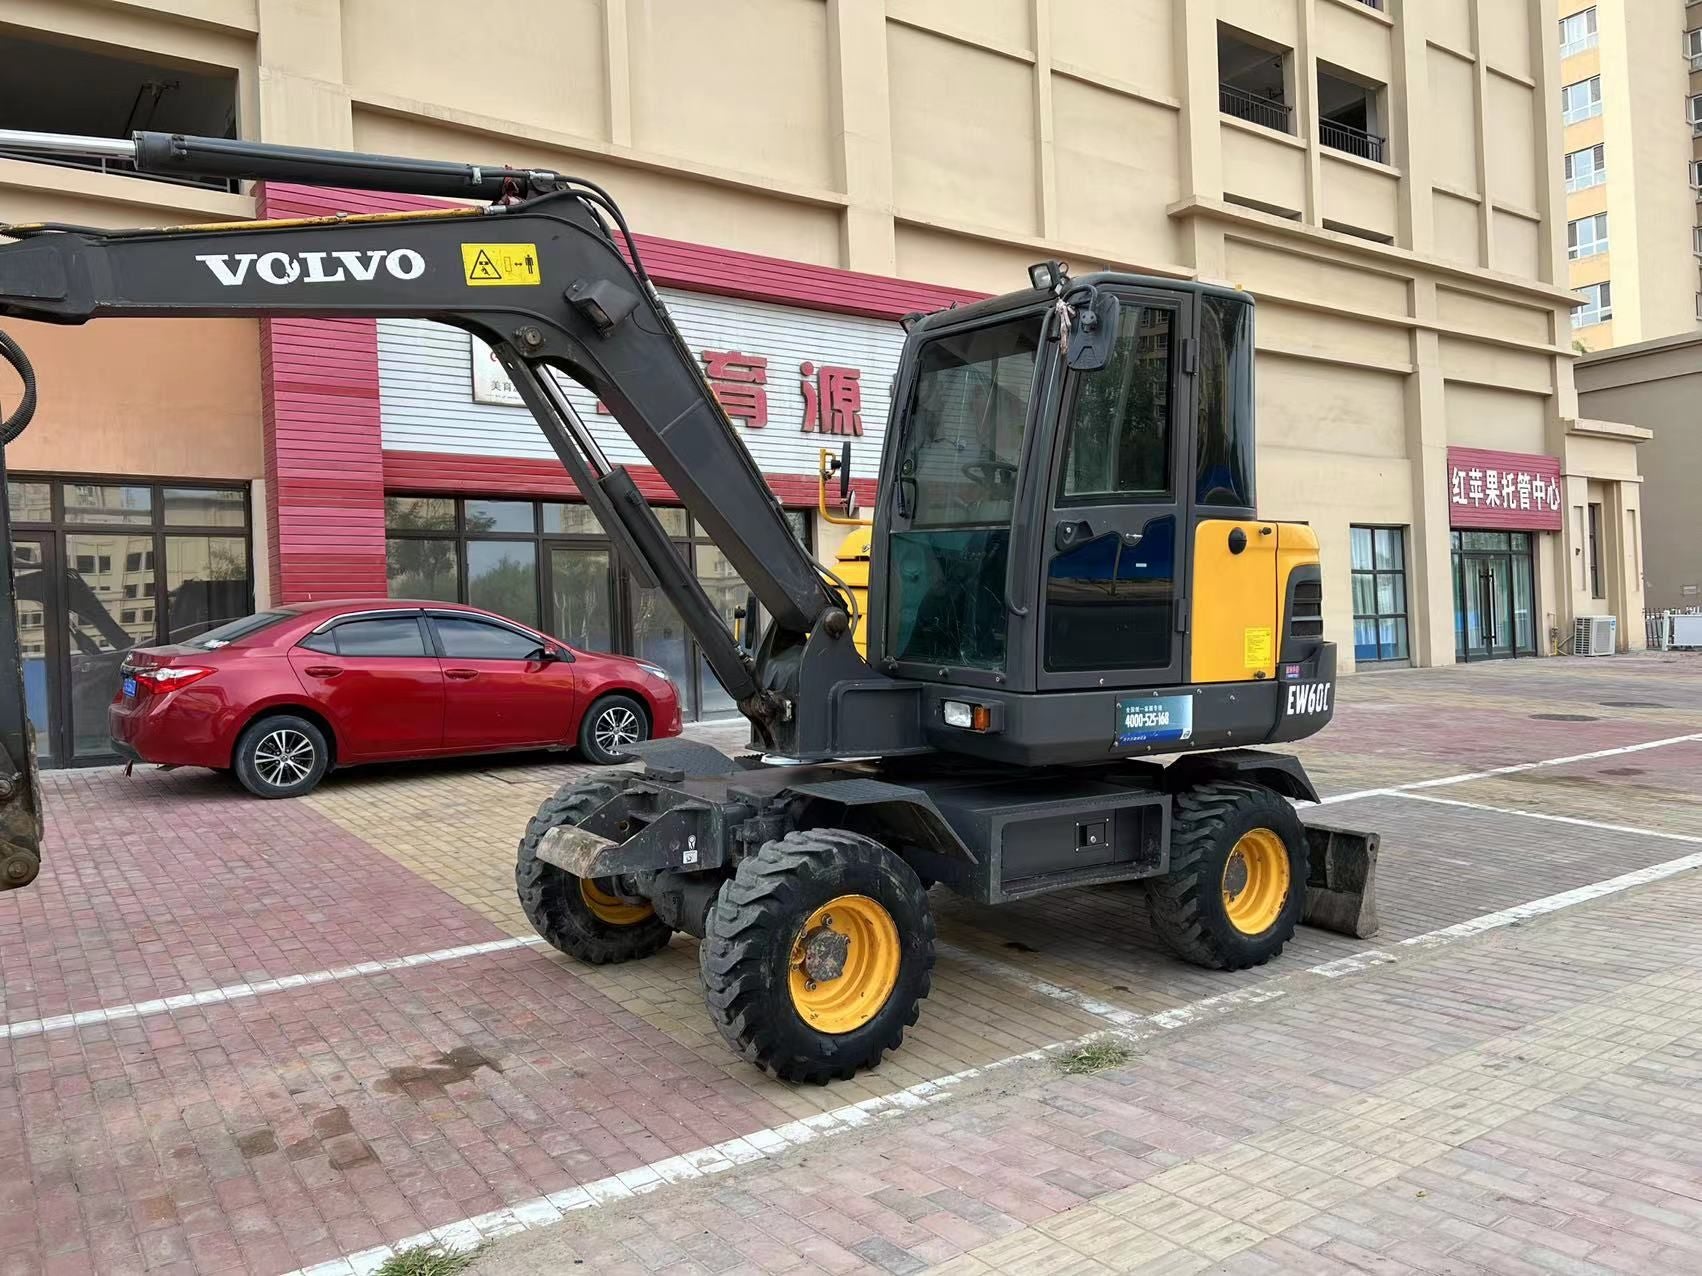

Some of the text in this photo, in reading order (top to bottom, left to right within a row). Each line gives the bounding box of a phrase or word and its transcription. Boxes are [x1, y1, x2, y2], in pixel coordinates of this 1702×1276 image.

[195, 248, 426, 286] VOLVO
[596, 350, 864, 436] 育源
[1452, 467, 1560, 510] 红苹果托管中心
[1287, 682, 1330, 715] EW60C
[1125, 711, 1170, 728] 4000-525-168
